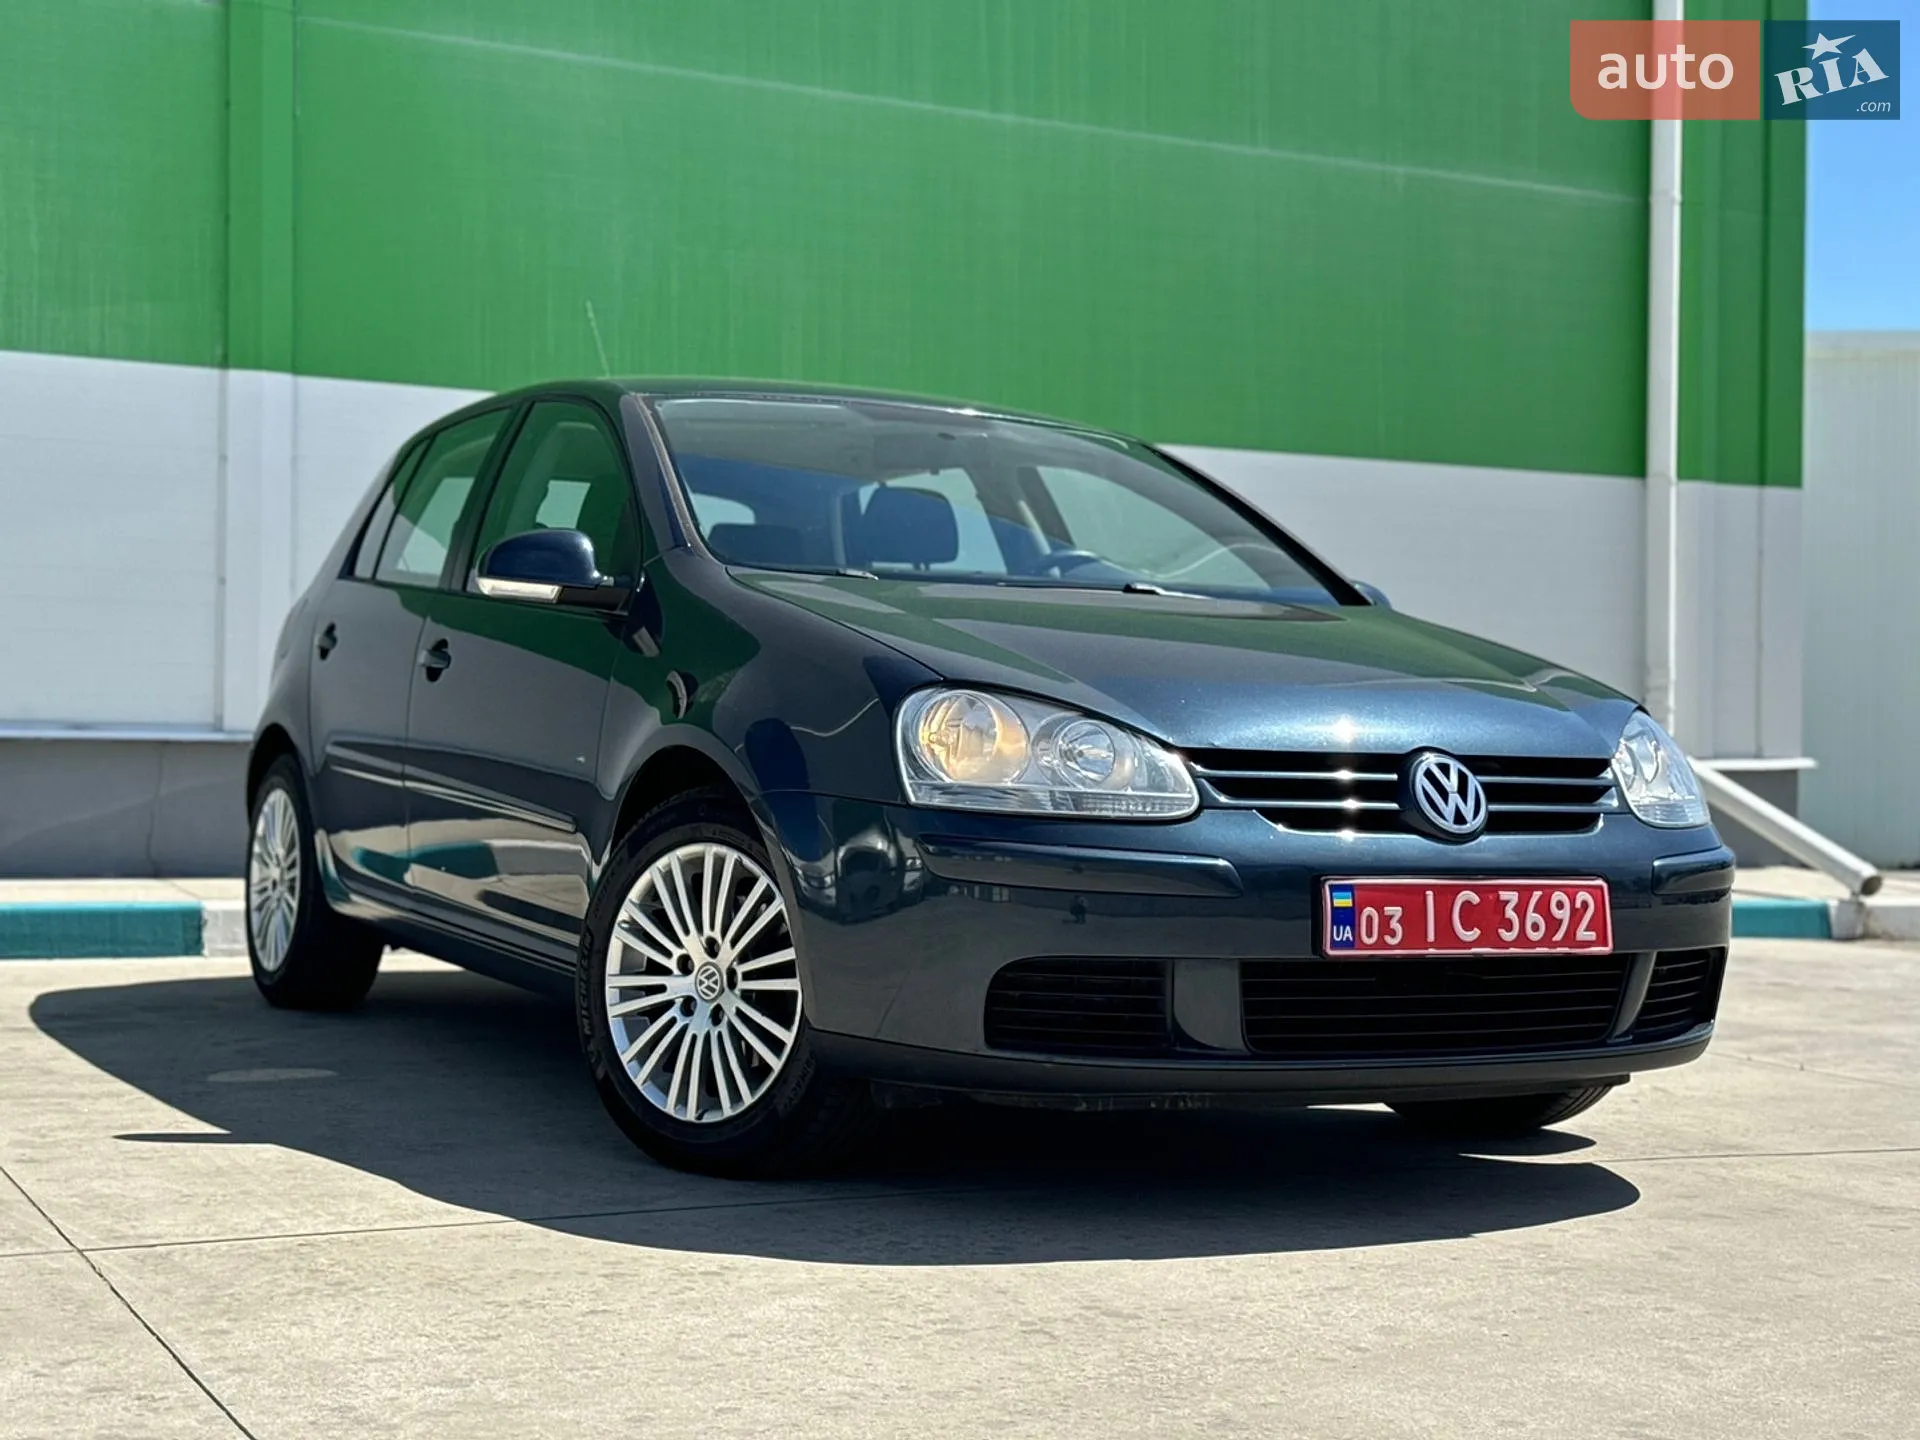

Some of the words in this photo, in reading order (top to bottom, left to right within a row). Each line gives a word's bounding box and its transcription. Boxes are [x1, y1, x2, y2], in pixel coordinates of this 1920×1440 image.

[1332, 924, 1353, 942] UA
[1360, 906, 1403, 945] 03
[1498, 890, 1597, 942] 3692
